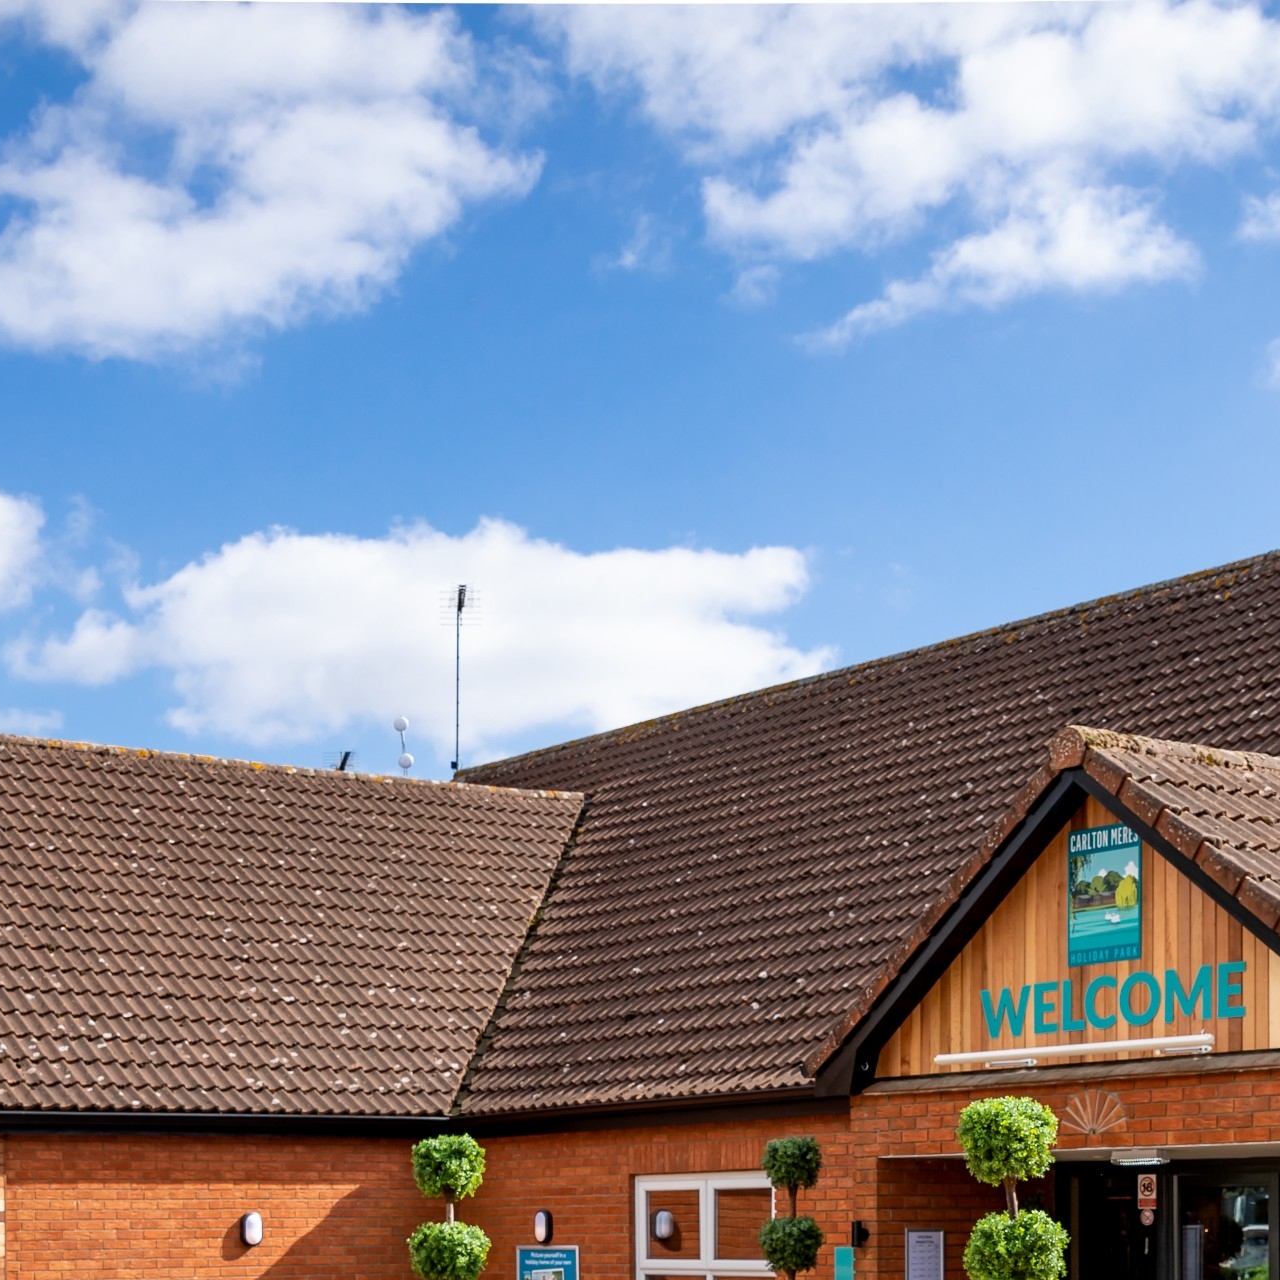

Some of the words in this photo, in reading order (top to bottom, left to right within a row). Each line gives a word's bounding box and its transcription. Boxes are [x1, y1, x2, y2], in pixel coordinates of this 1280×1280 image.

[1070, 830, 1109, 852] CARLTON
[1111, 826, 1139, 846] MERES
[1070, 950, 1110, 964] HOLIDAY
[1114, 946, 1138, 958] PARK
[980, 961, 1247, 1040] WELCOME
